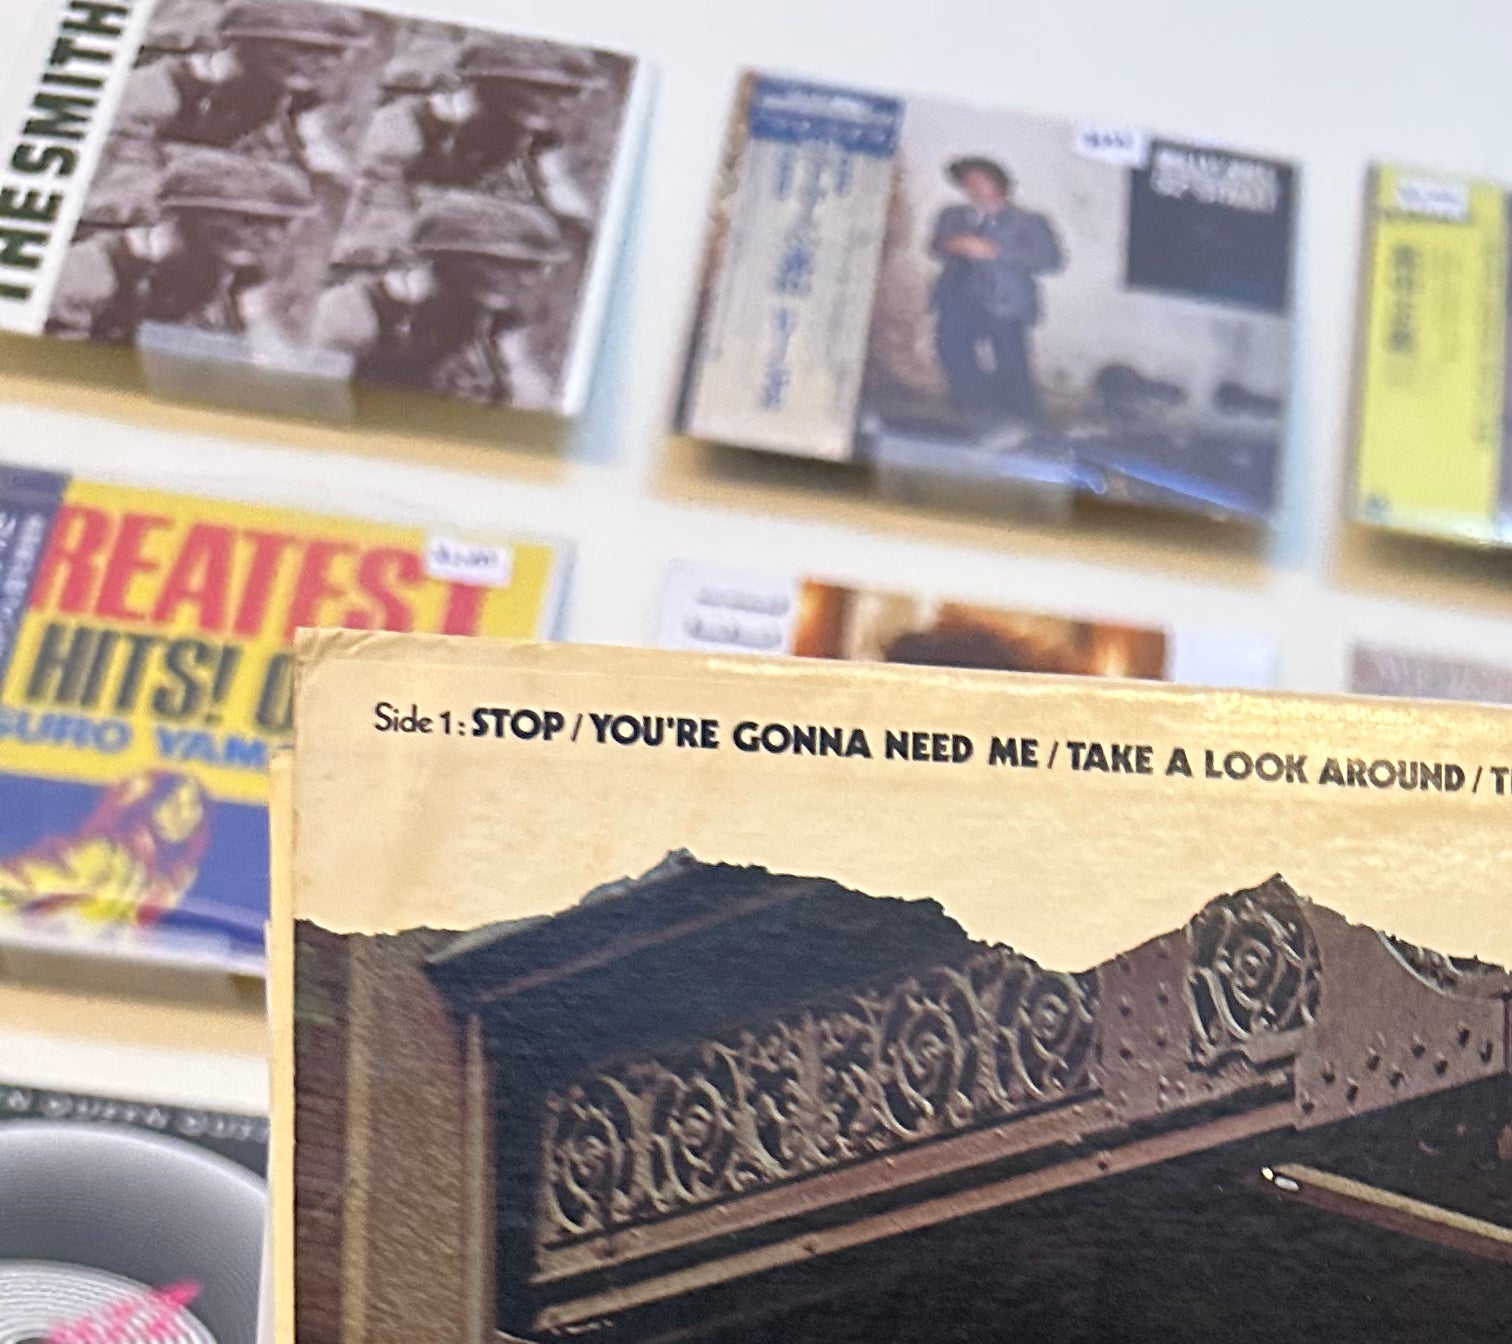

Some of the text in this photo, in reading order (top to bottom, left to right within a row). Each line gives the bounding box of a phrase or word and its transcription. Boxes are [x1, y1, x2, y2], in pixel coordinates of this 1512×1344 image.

[25, 622, 244, 727] HITS!
[373, 701, 433, 735] Side
[471, 707, 566, 742] STOP
[588, 712, 721, 751] YOU'RE
[731, 720, 874, 760] GONNA
[884, 728, 974, 765] NEED
[987, 735, 1039, 769] ME
[1066, 740, 1154, 775] TAKE
[1165, 746, 1193, 779] A
[1204, 748, 1309, 785] LOOK
[1318, 756, 1466, 793] AROUND
